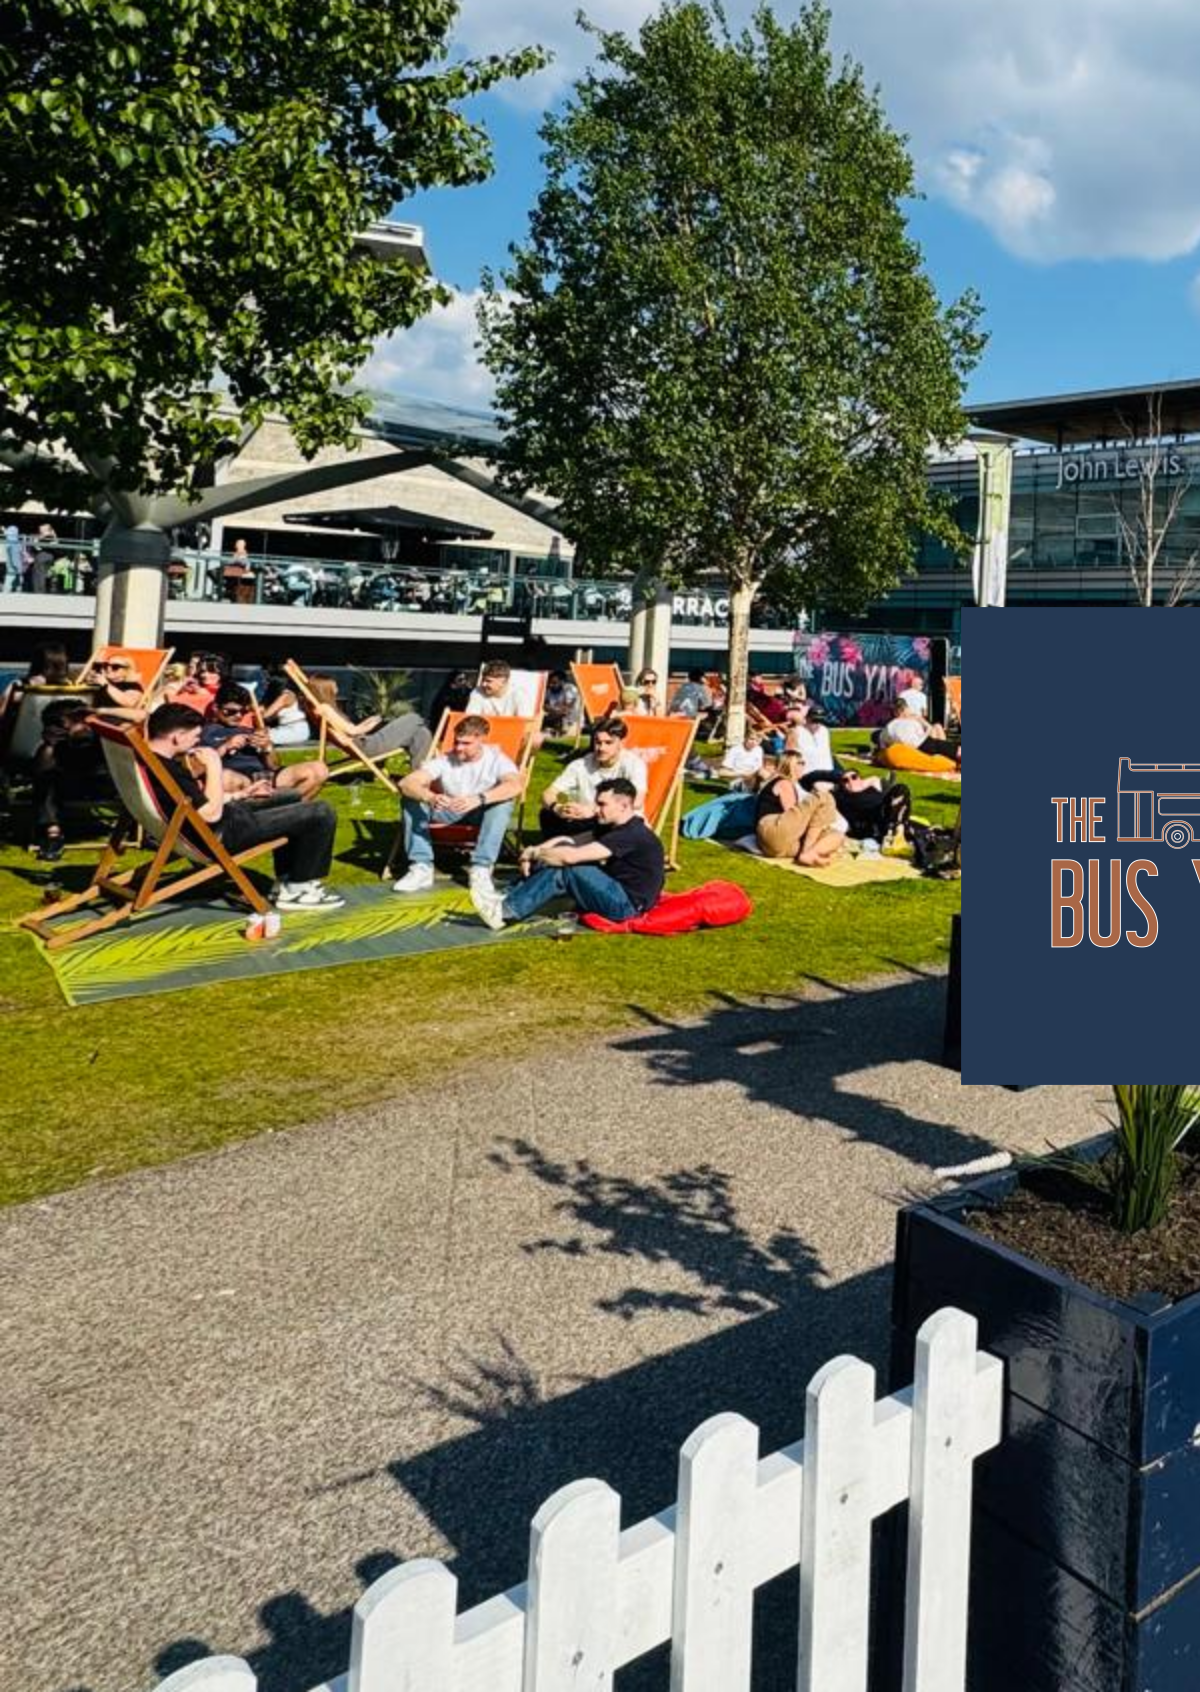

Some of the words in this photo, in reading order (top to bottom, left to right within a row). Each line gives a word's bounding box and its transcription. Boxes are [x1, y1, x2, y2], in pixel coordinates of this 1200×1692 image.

[1055, 453, 1107, 489] John
[671, 596, 731, 618] RRAC
[820, 661, 855, 698] BUS
